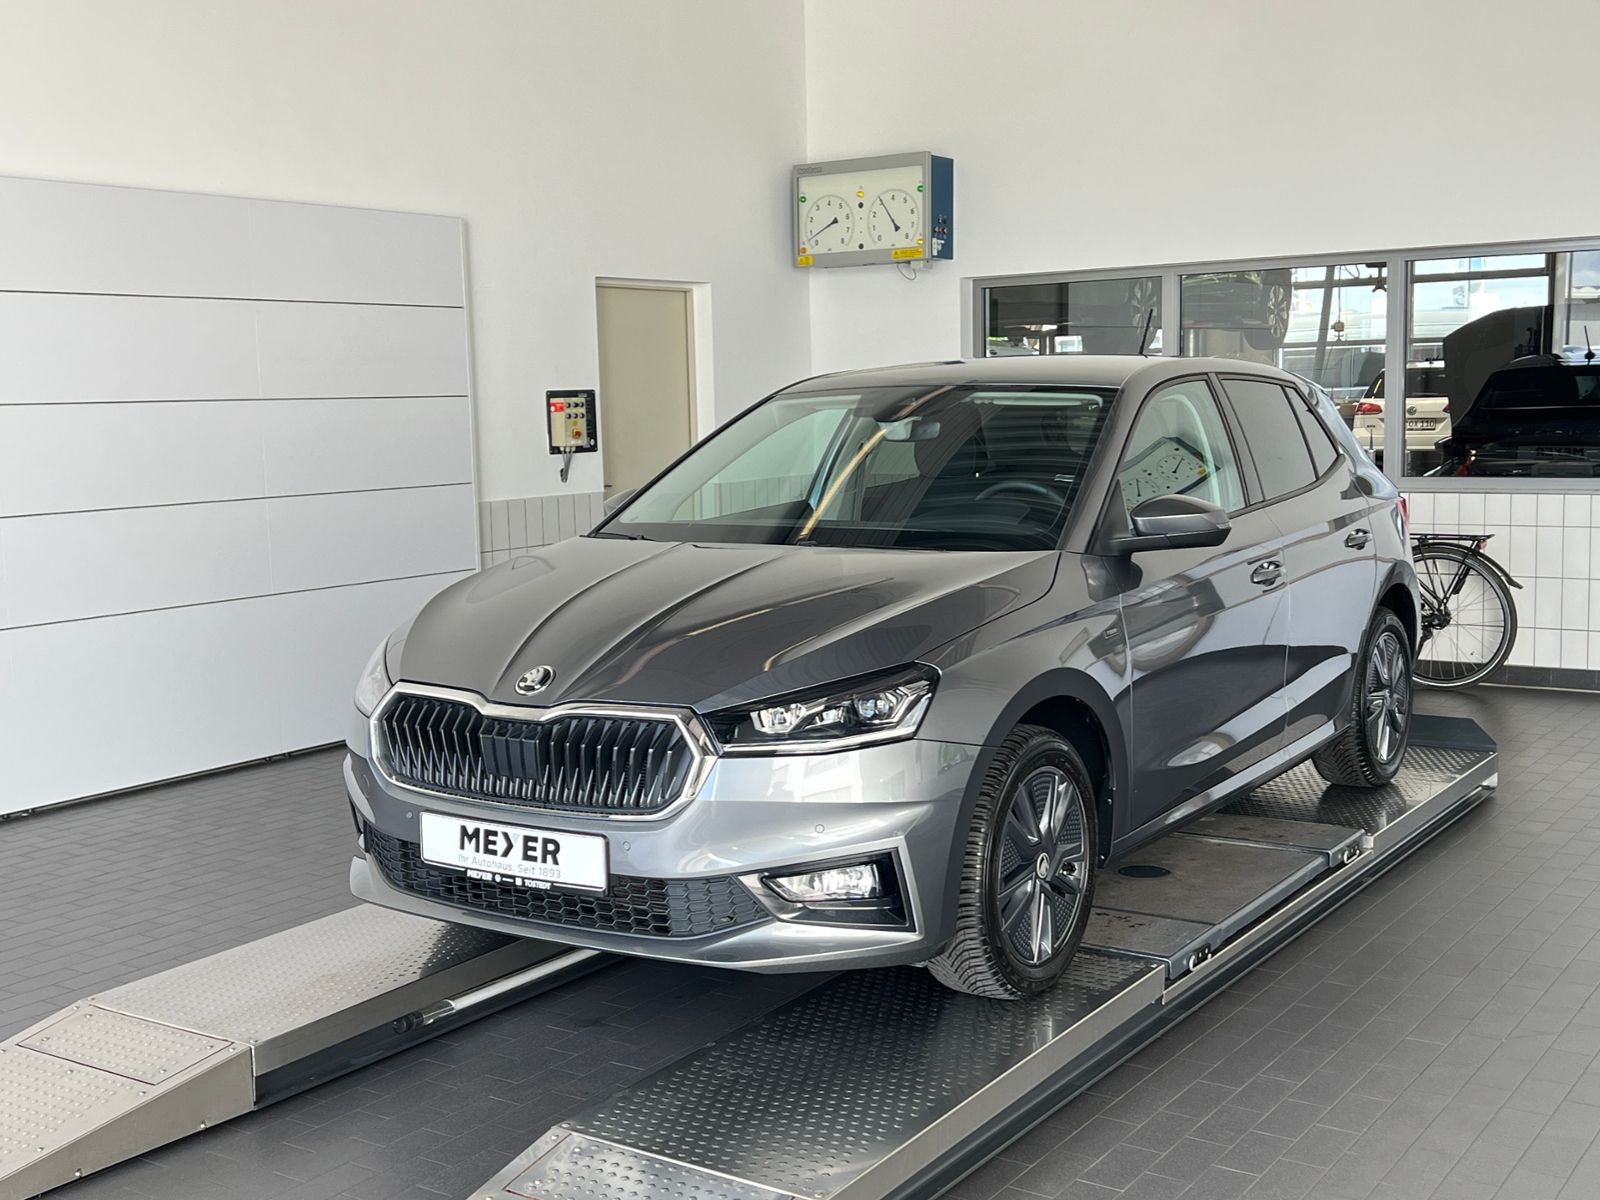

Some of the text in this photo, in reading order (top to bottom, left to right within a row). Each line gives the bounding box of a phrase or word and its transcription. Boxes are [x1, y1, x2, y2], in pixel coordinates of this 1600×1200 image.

[459, 824, 561, 866] MEYER
[458, 854, 561, 879] Ihr Autohaus. Seit 1893
